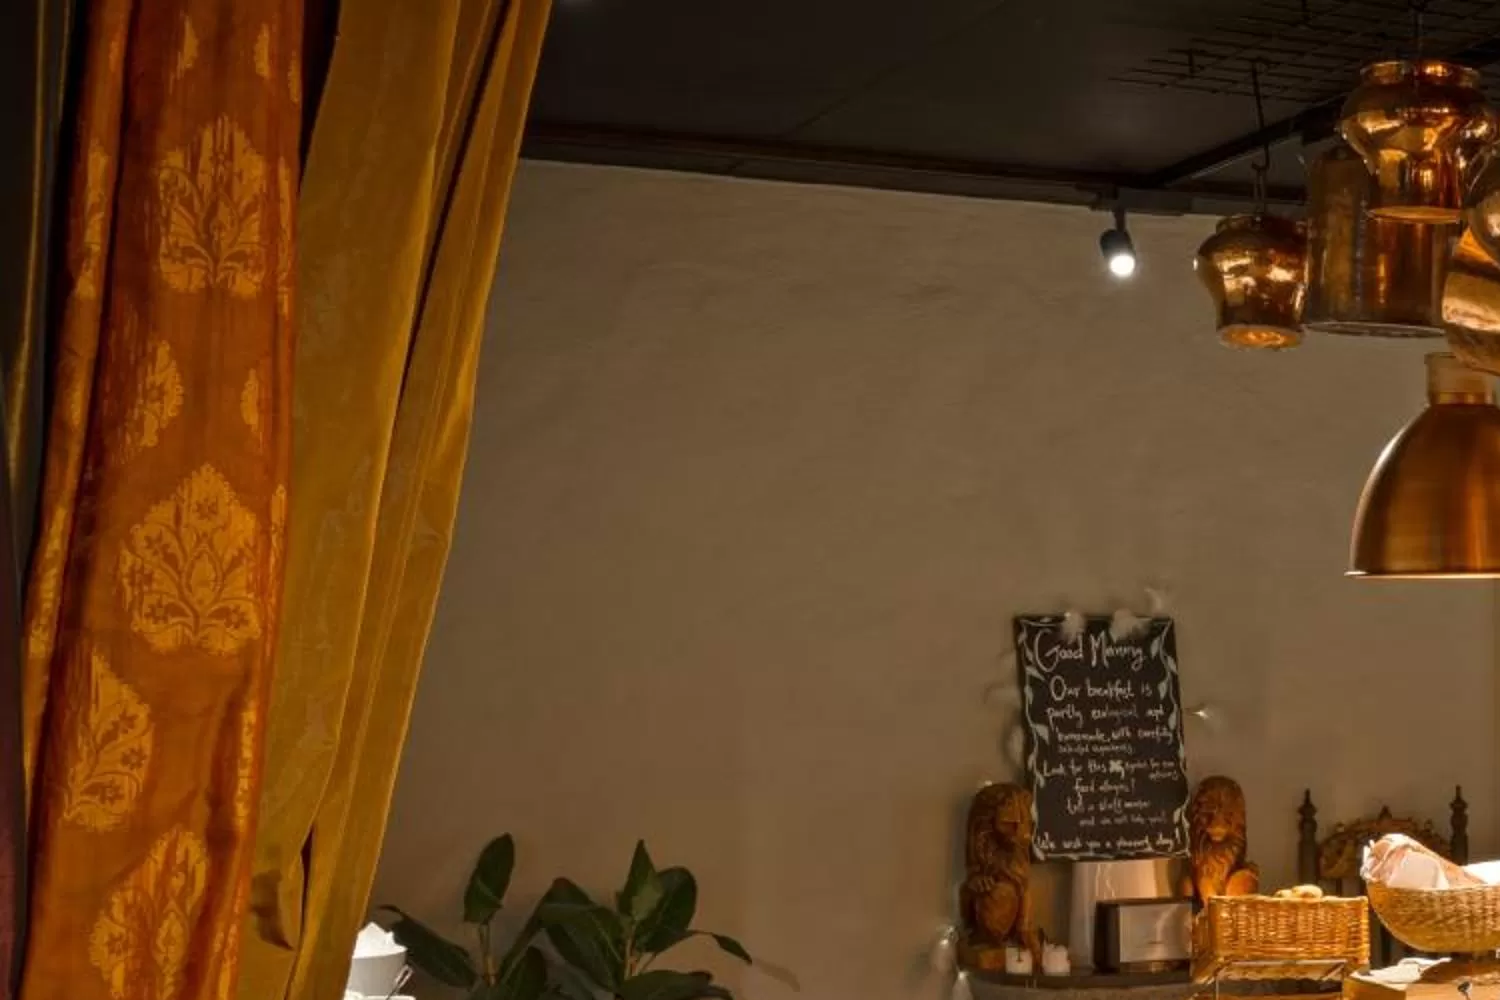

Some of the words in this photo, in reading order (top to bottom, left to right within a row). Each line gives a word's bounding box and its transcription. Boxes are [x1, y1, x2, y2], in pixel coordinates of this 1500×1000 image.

[1034, 628, 1084, 672] Good
[1090, 630, 1144, 672] Morning
[1049, 675, 1080, 701] Our
[1085, 677, 1135, 701] breakfast
[1141, 681, 1153, 697] is
[1046, 703, 1084, 729] partly
